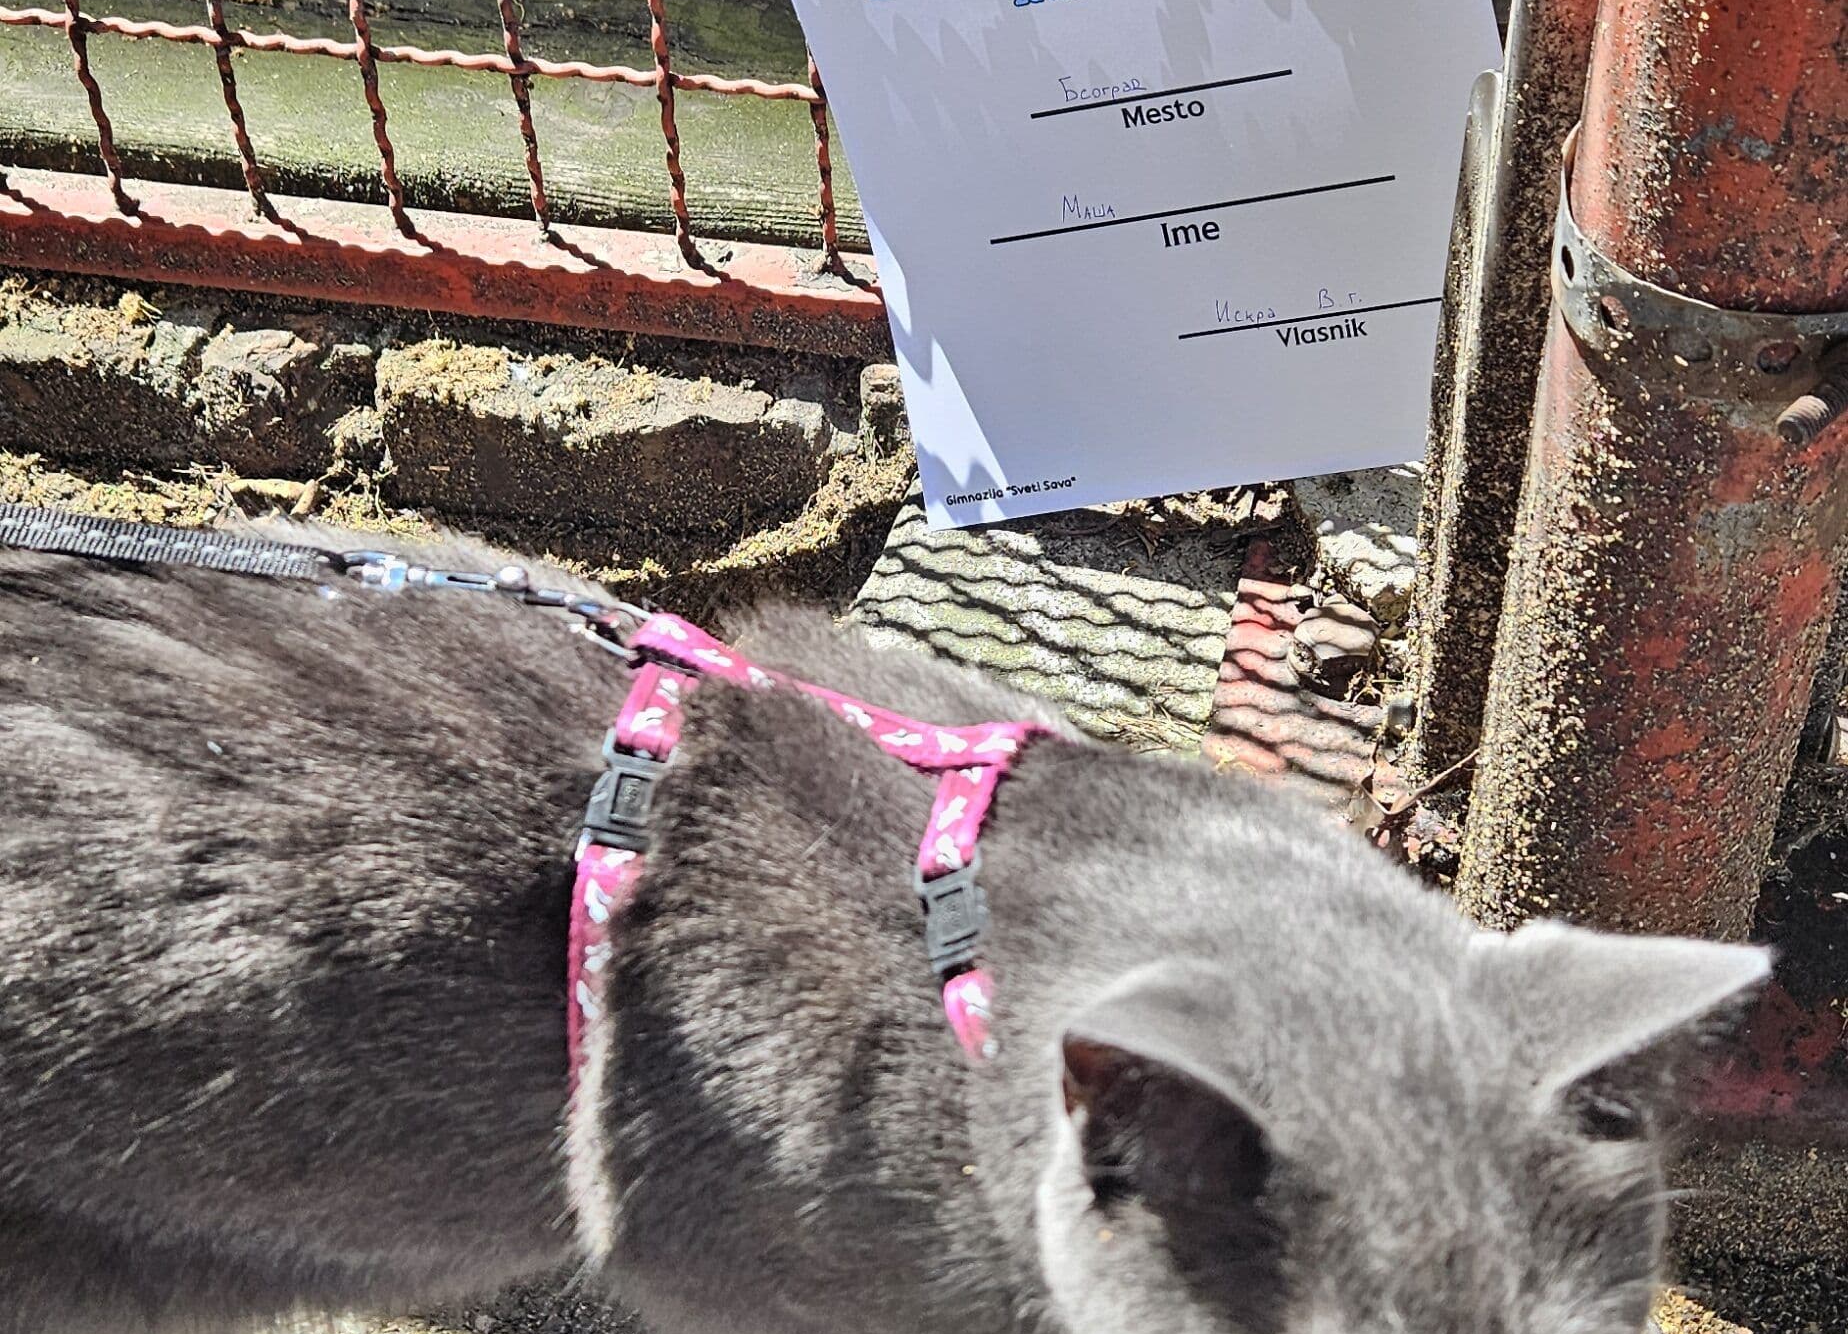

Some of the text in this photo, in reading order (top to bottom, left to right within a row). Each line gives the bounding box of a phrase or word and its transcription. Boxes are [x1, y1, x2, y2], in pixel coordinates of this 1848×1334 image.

[1120, 99, 1206, 129] Mesto
[1062, 193, 1116, 224] Маша
[1160, 221, 1220, 248] Ime
[1275, 317, 1369, 348] Vlasnik
[945, 476, 1077, 506] Gimnazija "Sveti Sava"
